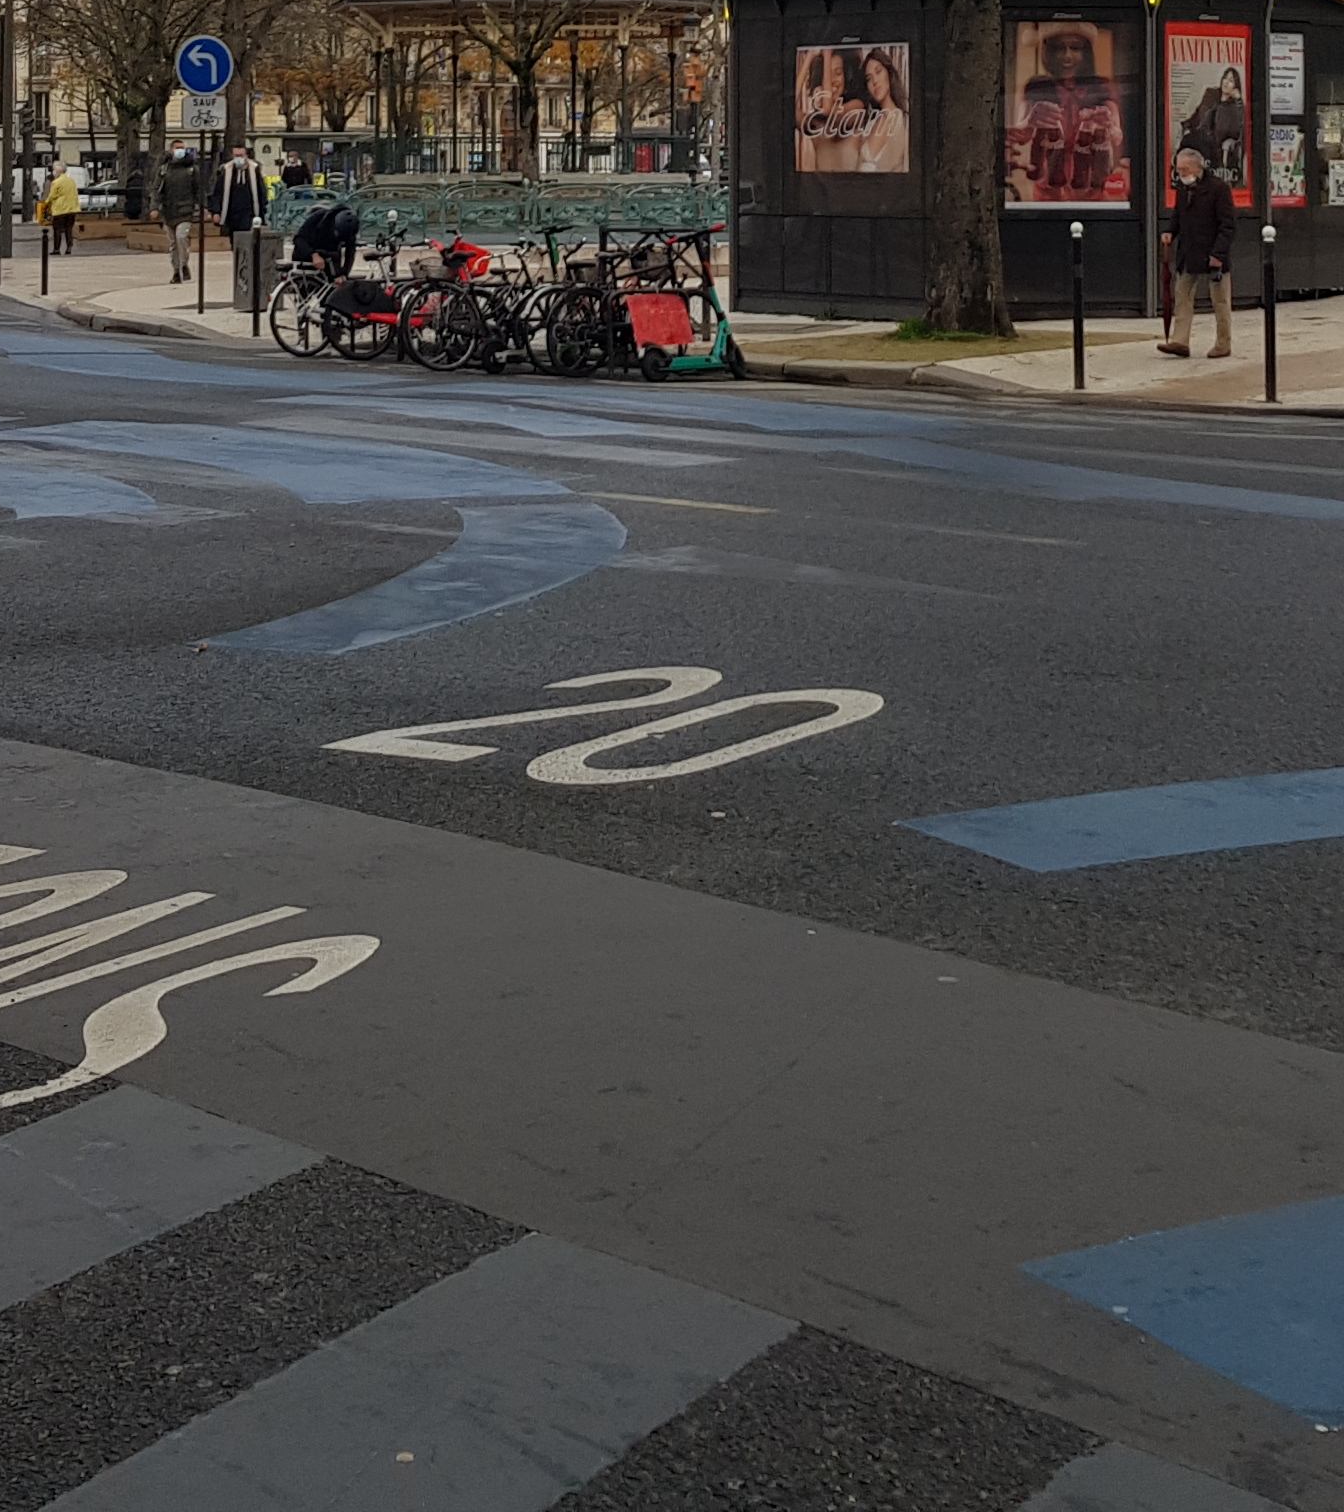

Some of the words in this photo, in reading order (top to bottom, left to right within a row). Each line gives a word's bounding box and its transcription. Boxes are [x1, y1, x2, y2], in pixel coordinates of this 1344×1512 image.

[1171, 37, 1213, 64] VANITY
[1216, 39, 1244, 64] FAIR
[193, 98, 217, 107] SAUF
[320, 665, 885, 785] 20
